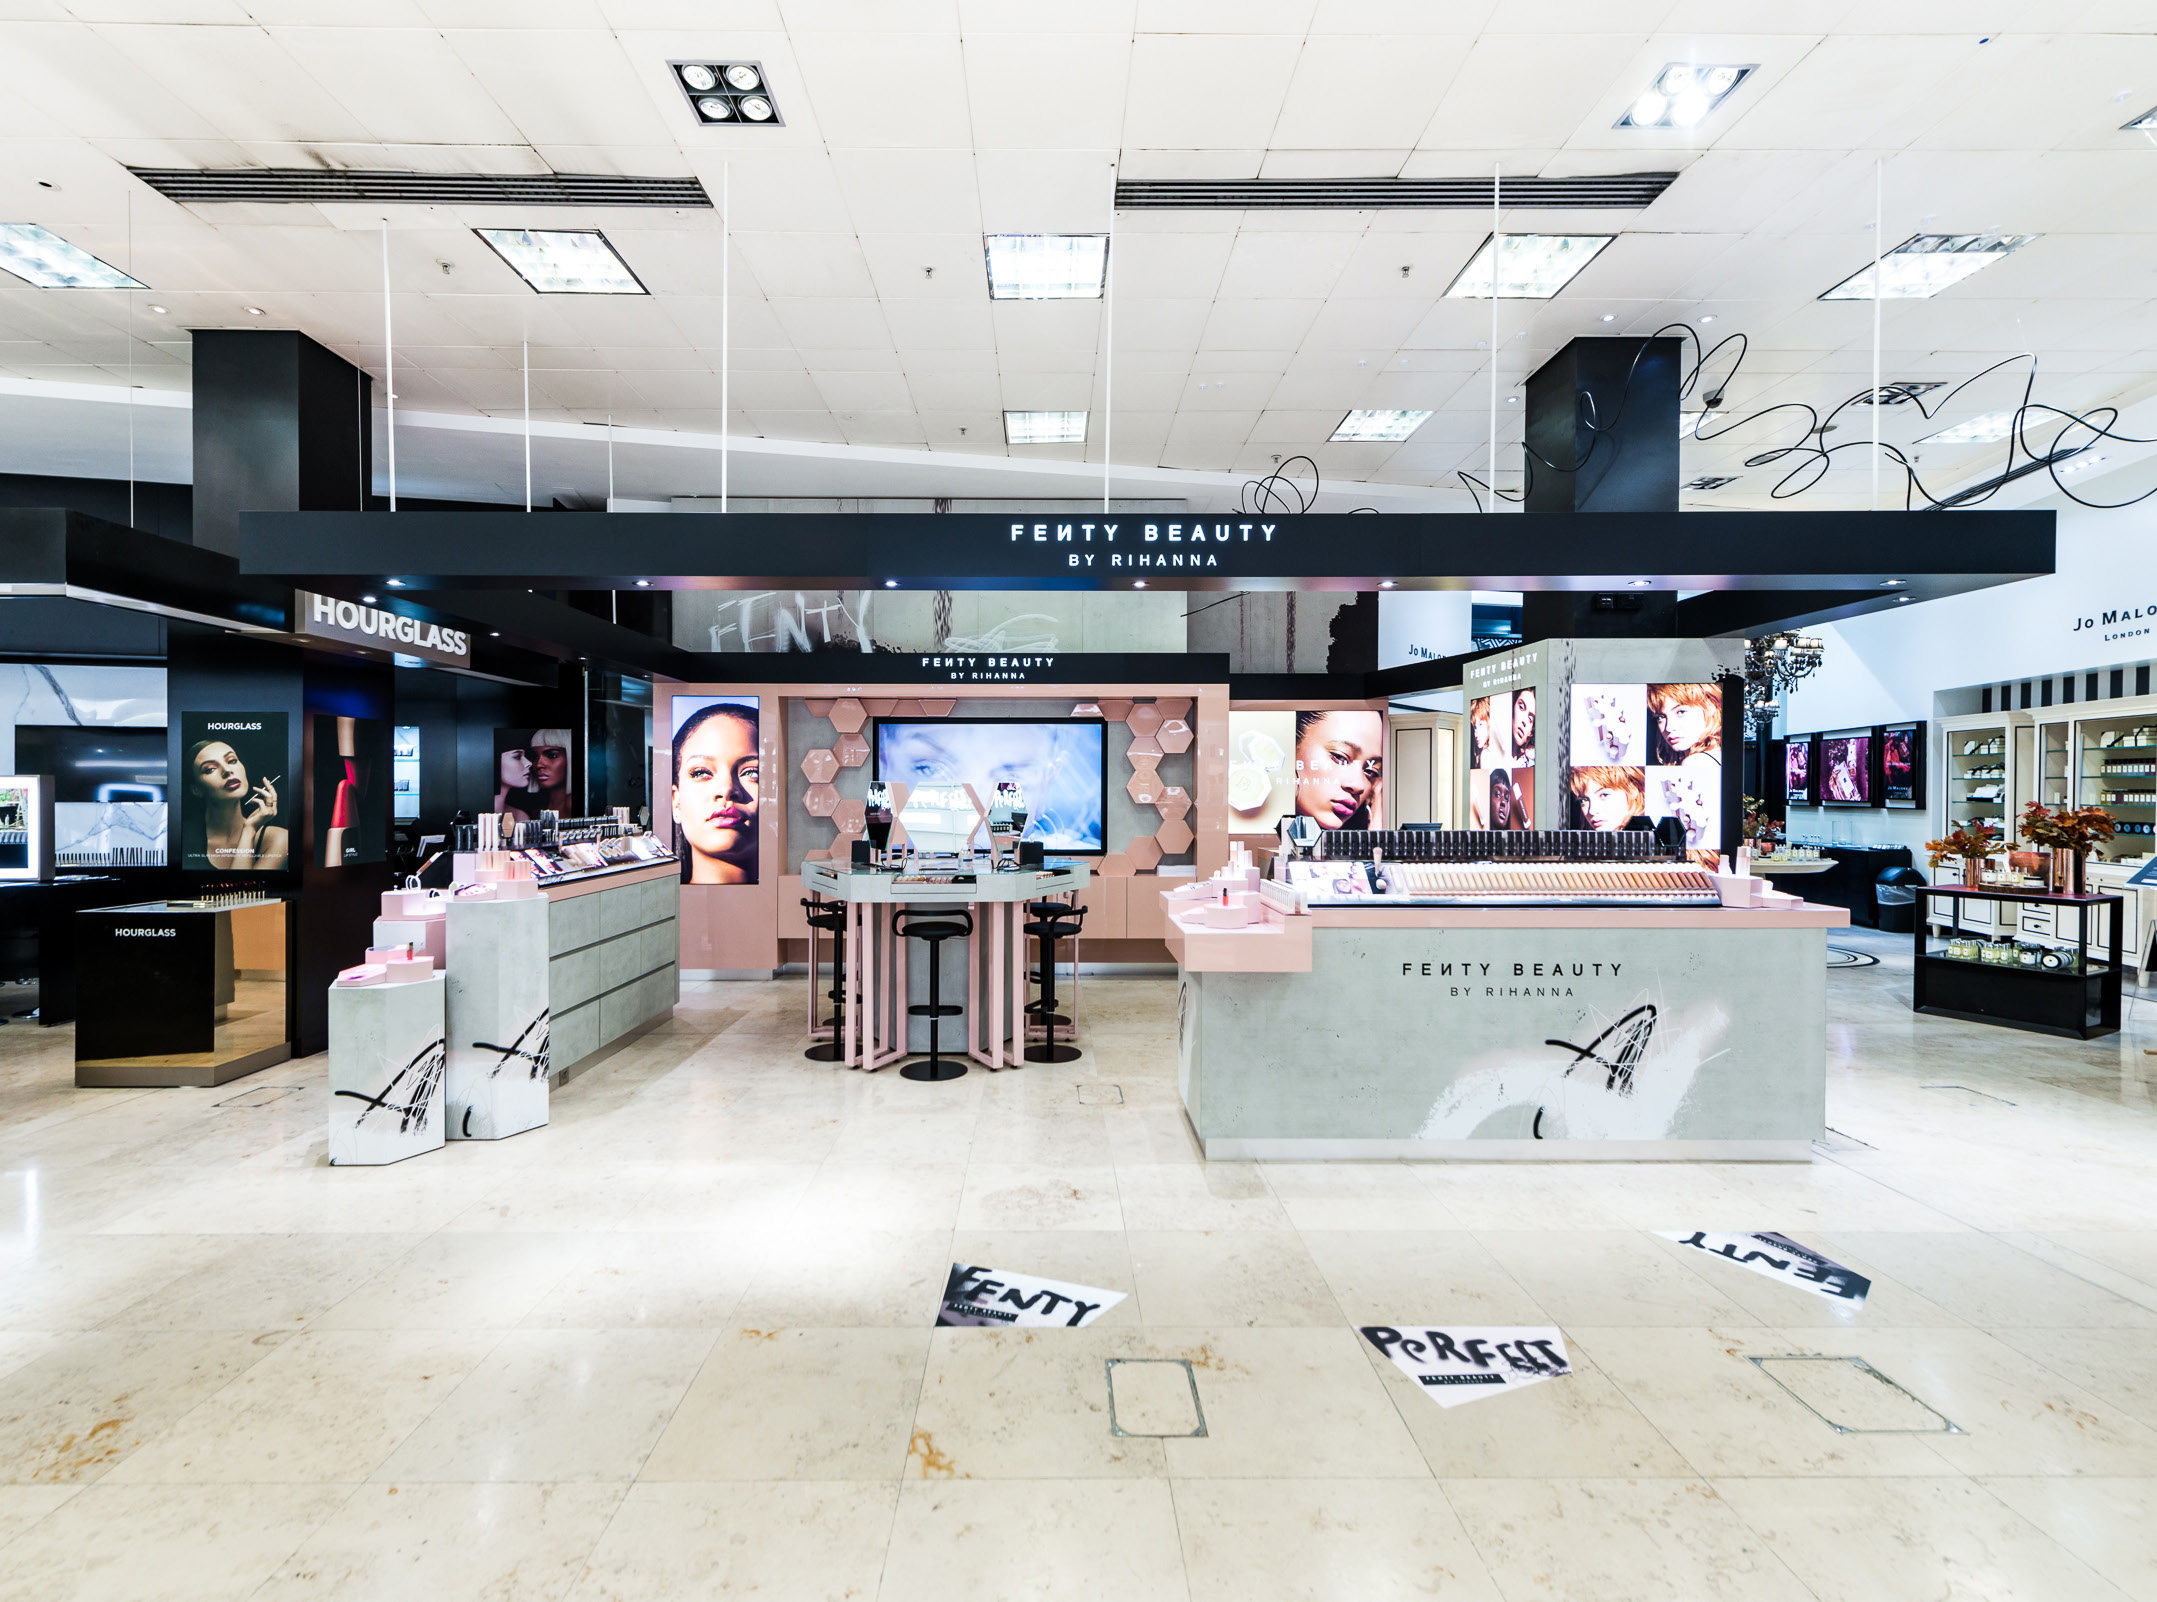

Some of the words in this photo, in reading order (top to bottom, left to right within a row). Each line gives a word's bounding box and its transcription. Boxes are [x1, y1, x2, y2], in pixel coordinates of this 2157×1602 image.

[1144, 524, 1276, 542] BEAUTY
[1068, 554, 1095, 567] BY
[1111, 554, 1218, 567] RIHANNA
[313, 593, 467, 656] HOURGLASS
[2104, 628, 2150, 641] LONDON
[988, 658, 1054, 667] BEAUTY
[1500, 652, 1538, 671] BEAUTY
[950, 672, 965, 680] BY
[972, 672, 1025, 680] RIHANNA
[207, 722, 262, 731] HOURGLASS
[1276, 777, 1341, 785] RIHANNA
[115, 928, 177, 937] HOURGLASS
[1513, 963, 1622, 976] BEAUTY
[1450, 987, 1471, 997] BY
[1486, 987, 1573, 997] RIHANNA
